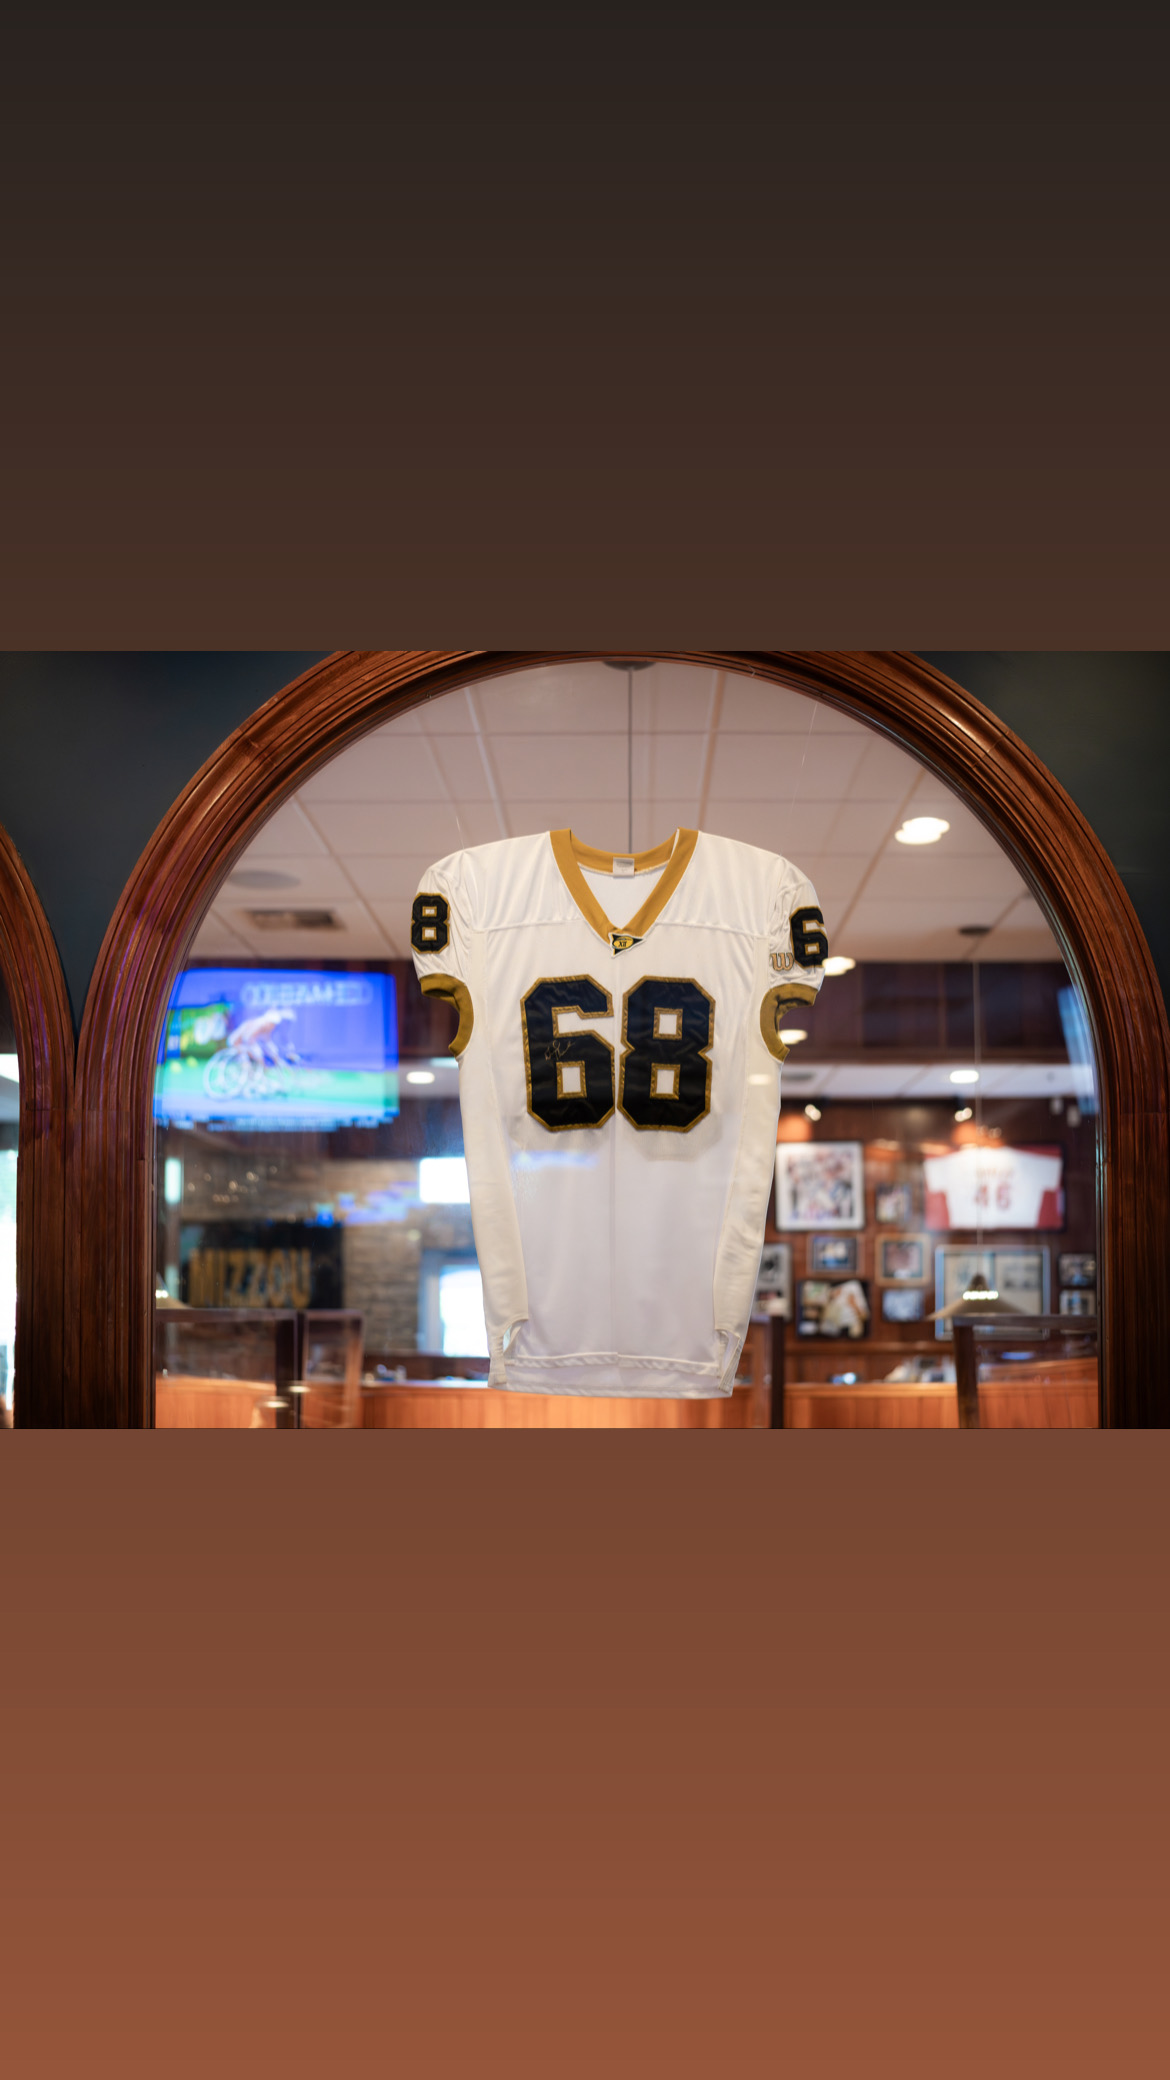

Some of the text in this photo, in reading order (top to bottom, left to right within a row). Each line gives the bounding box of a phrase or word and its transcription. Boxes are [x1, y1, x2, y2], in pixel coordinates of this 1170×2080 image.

[411, 892, 451, 954] 8
[789, 905, 828, 969] 6
[520, 974, 716, 1132] 68
[974, 1184, 1011, 1210] 46
[189, 1248, 312, 1308] MIZZOU
